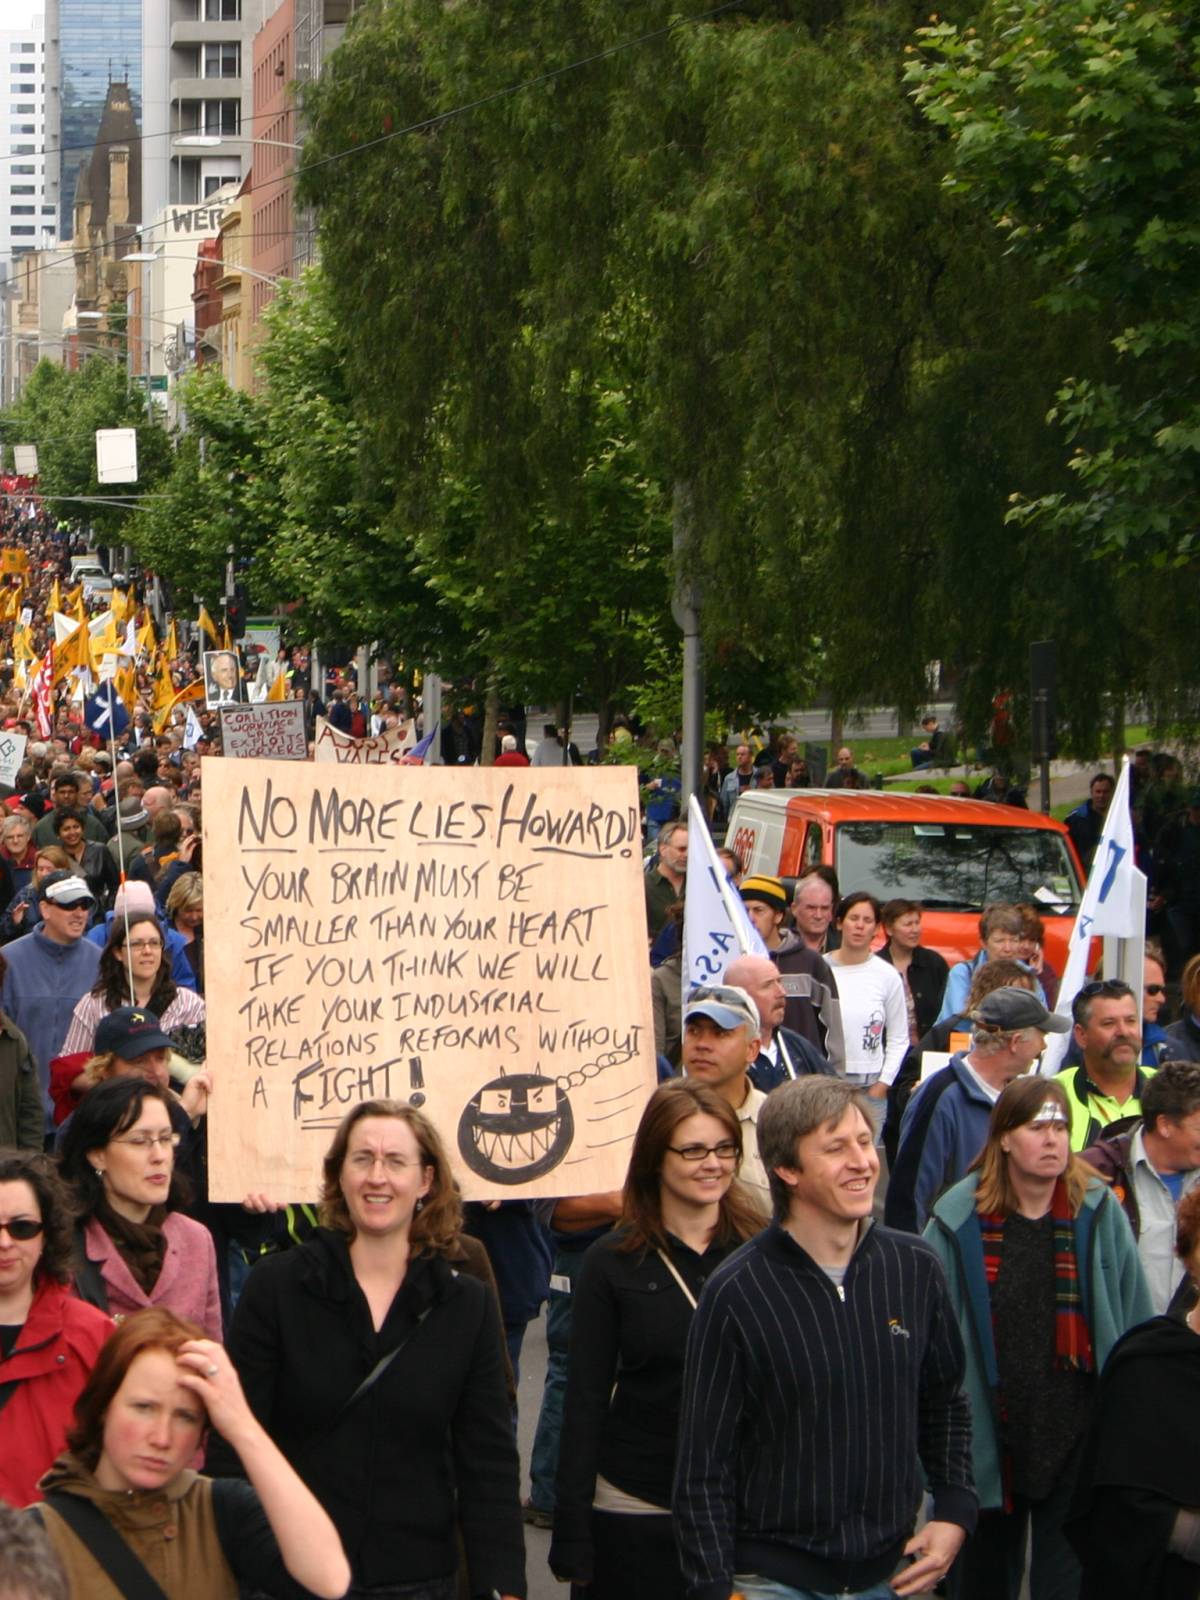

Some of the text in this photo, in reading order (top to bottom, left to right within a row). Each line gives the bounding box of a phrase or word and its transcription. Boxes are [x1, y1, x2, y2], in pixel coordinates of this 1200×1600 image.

[224, 708, 298, 725] COALITION
[230, 733, 305, 749] EXPLOITS
[236, 744, 306, 759] WORKERS
[238, 778, 297, 844] NO
[309, 786, 404, 844] MORE
[409, 801, 493, 840] LIES
[242, 859, 543, 911] YOUR BRAIN MUST BE
[240, 904, 608, 948] SMALLER THAN YOUR HEART
[245, 949, 609, 991] IF YOU THINK WE WILL
[239, 988, 560, 1031] TAKE YOUR INDUSTRIAL
[246, 1020, 644, 1067] RELATIONS REFORMS WITHOUT
[252, 1056, 426, 1120] A FIGHT!
